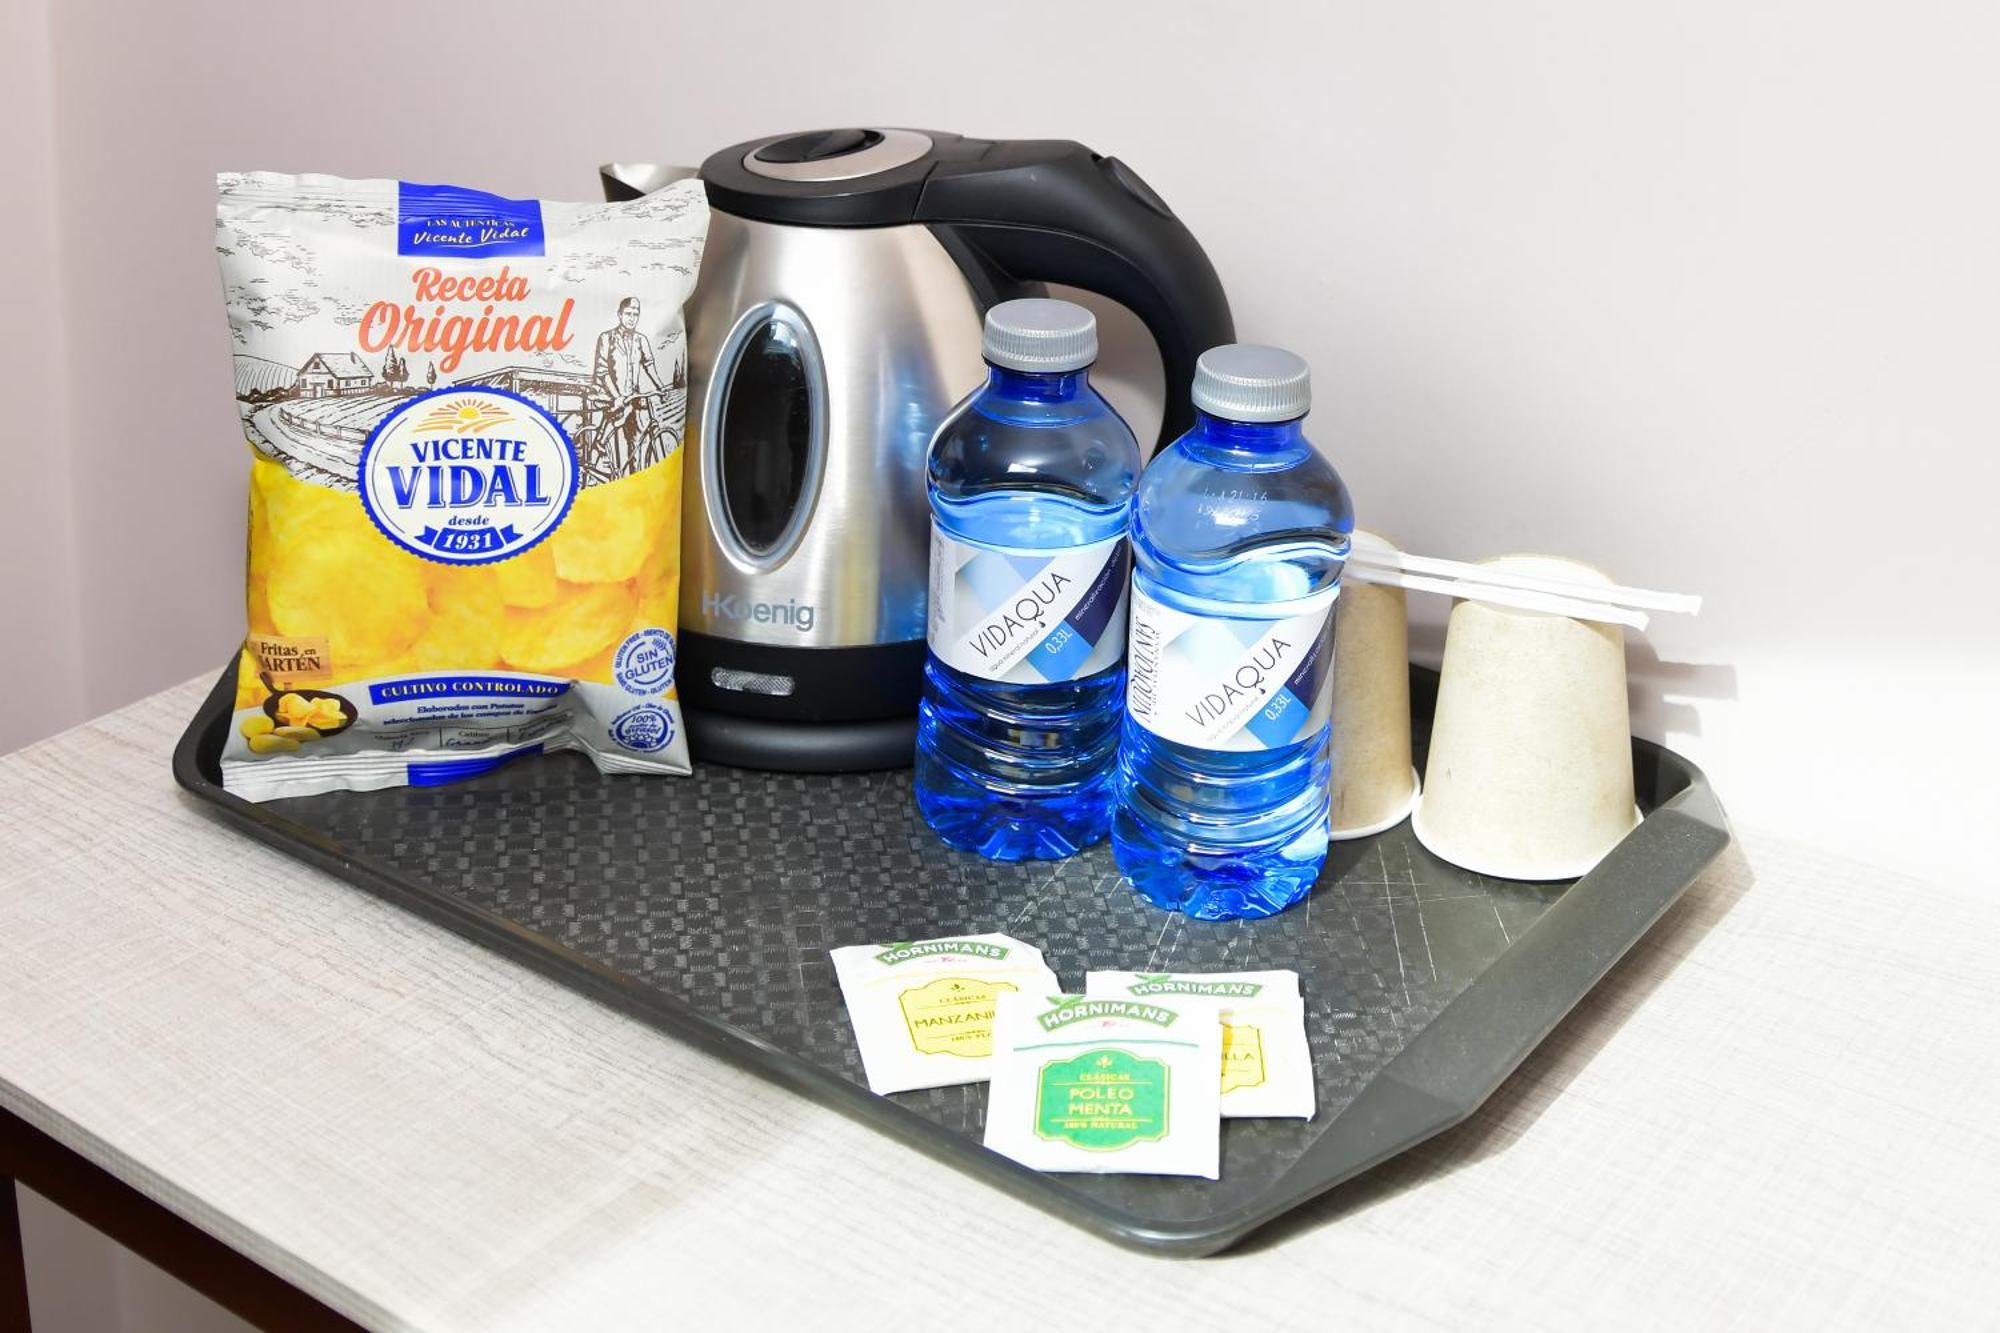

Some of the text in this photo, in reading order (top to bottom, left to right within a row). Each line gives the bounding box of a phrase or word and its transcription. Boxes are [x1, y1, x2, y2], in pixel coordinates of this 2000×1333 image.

[413, 227, 530, 245] Vicente Vidal
[412, 266, 531, 302] Receta
[358, 298, 575, 374] Original
[410, 438, 527, 463] VICENTE
[385, 464, 551, 509] VIDAL
[448, 515, 490, 526] desde
[443, 532, 493, 550] 1931
[969, 572, 1071, 657] VIDAQUA
[260, 641, 298, 656] Fritas
[637, 648, 658, 663] SIN
[625, 655, 673, 679] GLUTEN
[381, 681, 559, 698] CULTIVO CONTROLADO
[1185, 638, 1291, 727] VIDAQUA
[883, 943, 1001, 962] HORNIMANS
[1135, 983, 1255, 994] HORNIMANS
[1044, 1002, 1170, 1027] HORNIMANS
[1070, 1088, 1134, 1100] POLEO
[1069, 1103, 1132, 1115] MENTA
